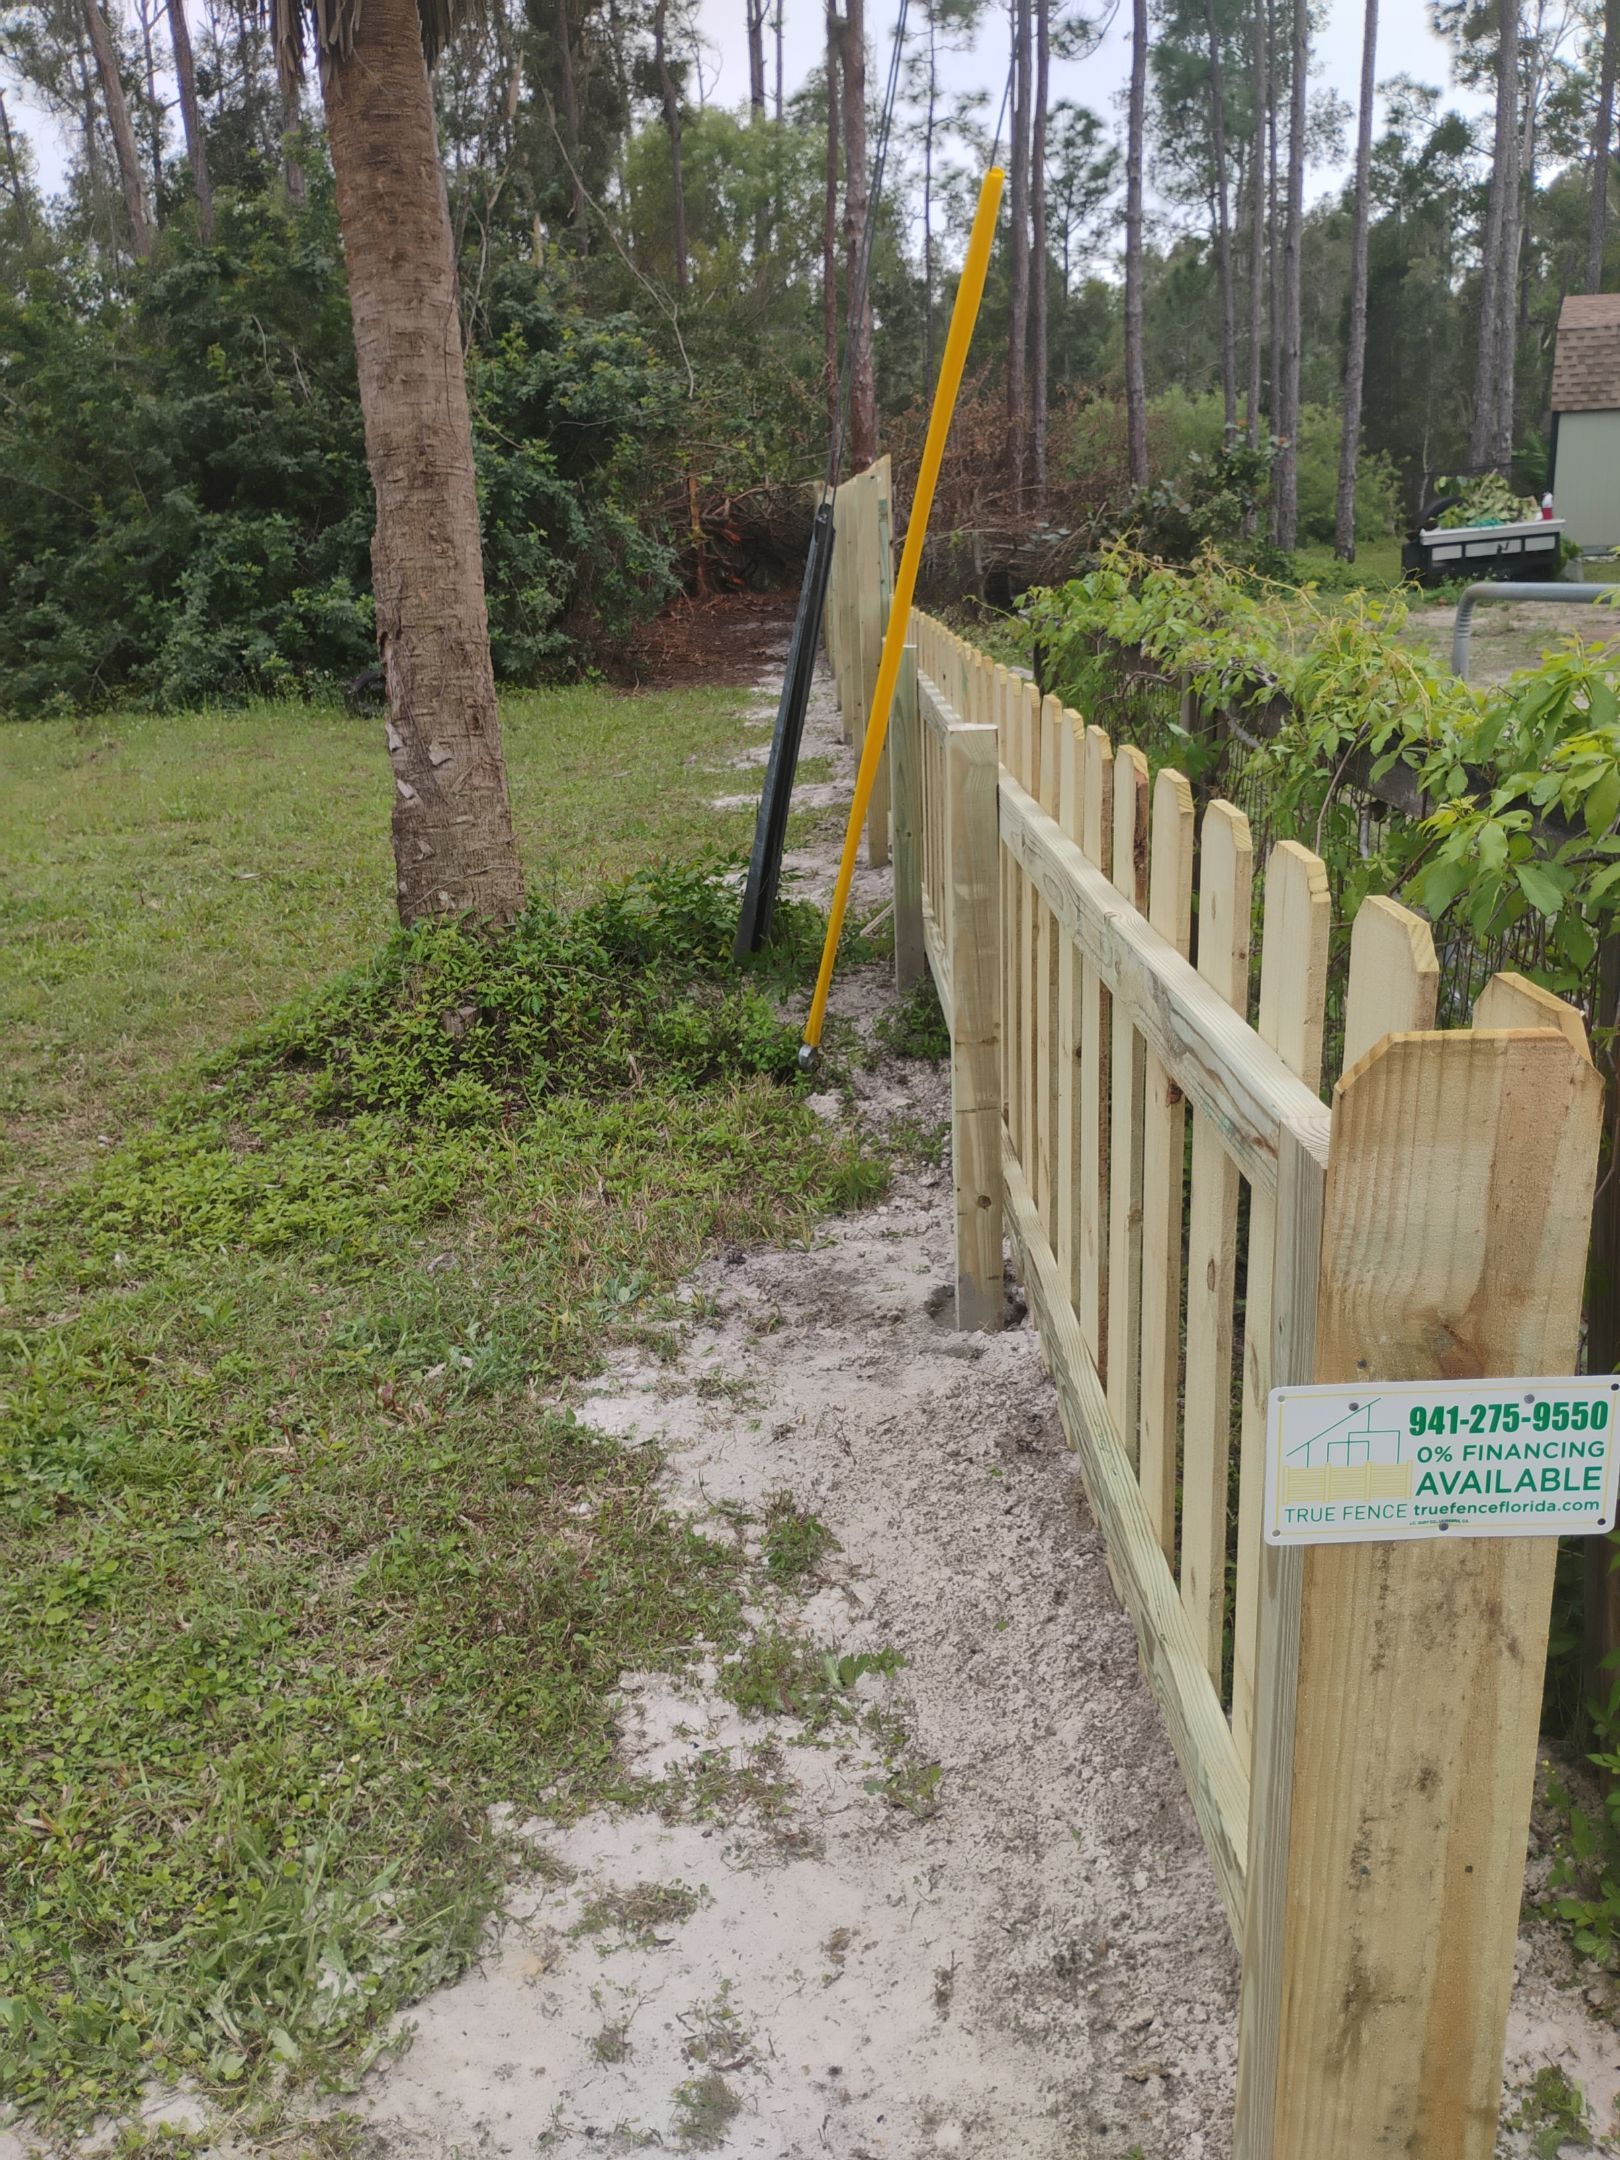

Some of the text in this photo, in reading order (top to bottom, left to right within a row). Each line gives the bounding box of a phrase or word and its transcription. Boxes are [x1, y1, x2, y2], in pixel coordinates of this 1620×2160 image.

[1409, 1400, 1609, 1437] 941-275-9550
[1417, 1440, 1605, 1463] 0% FINANCING
[1415, 1466, 1603, 1496] AVAILABLE
[1284, 1503, 1407, 1524] TRUE FENCE
[1414, 1499, 1600, 1516] truefenceflorida.com
